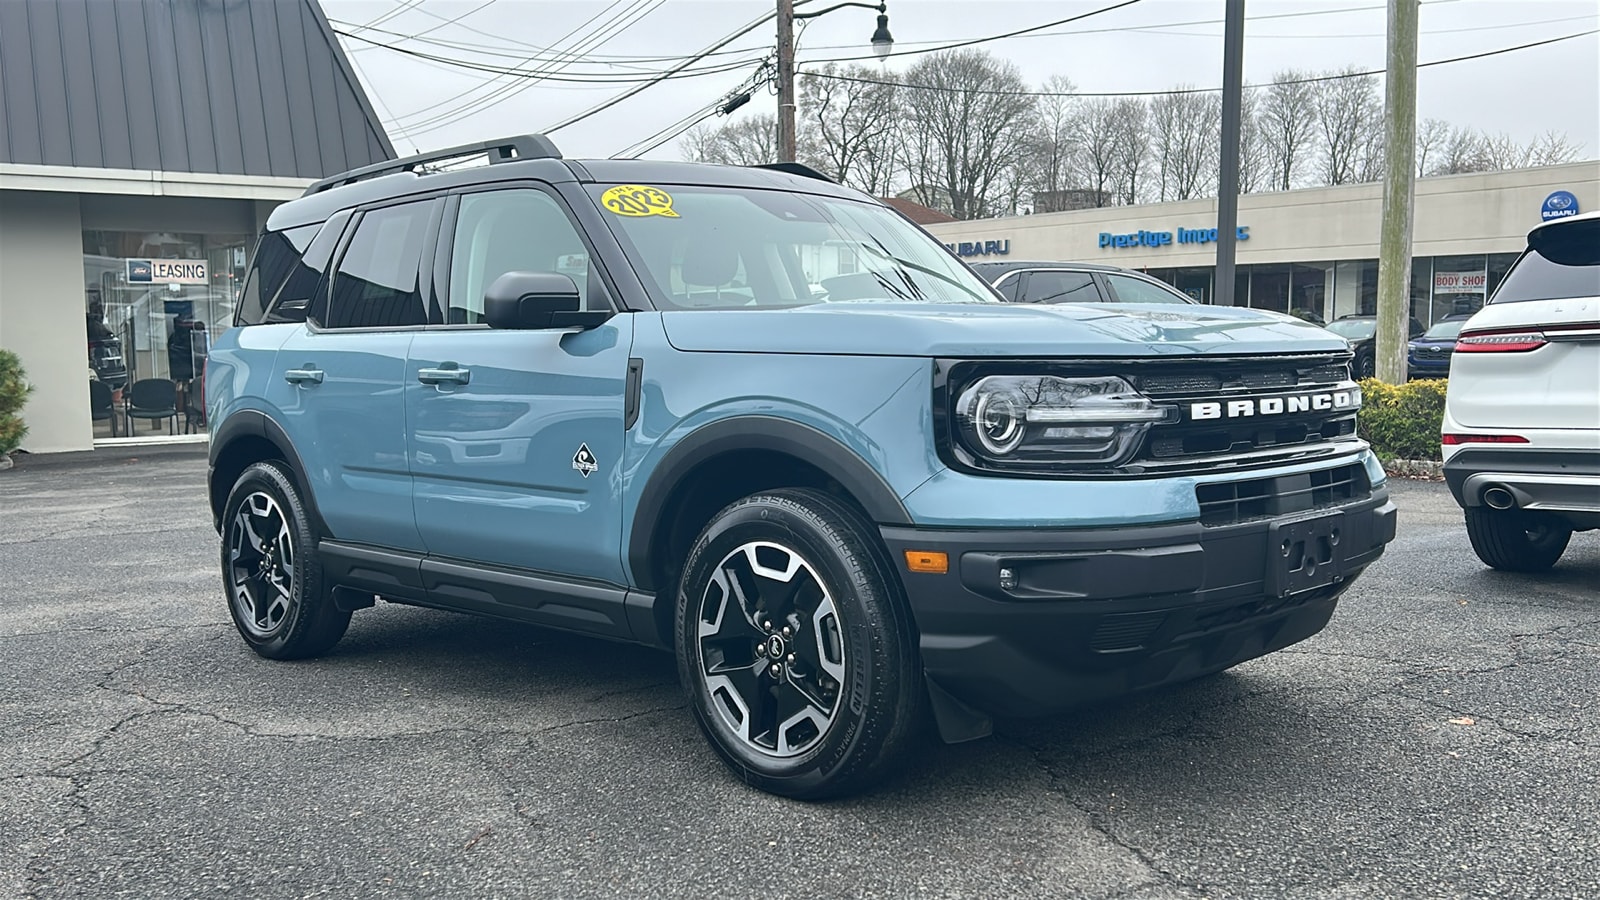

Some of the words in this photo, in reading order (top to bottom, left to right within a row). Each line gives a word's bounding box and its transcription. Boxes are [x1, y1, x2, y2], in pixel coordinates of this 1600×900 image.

[607, 188, 670, 214] 2023
[1099, 230, 1172, 248] Prestige
[1177, 226, 1250, 244] Impos
[945, 239, 1010, 257] UBARU
[153, 264, 205, 279] LEASING
[1436, 276, 1460, 286] BODY
[1191, 392, 1350, 420] BRONCO
